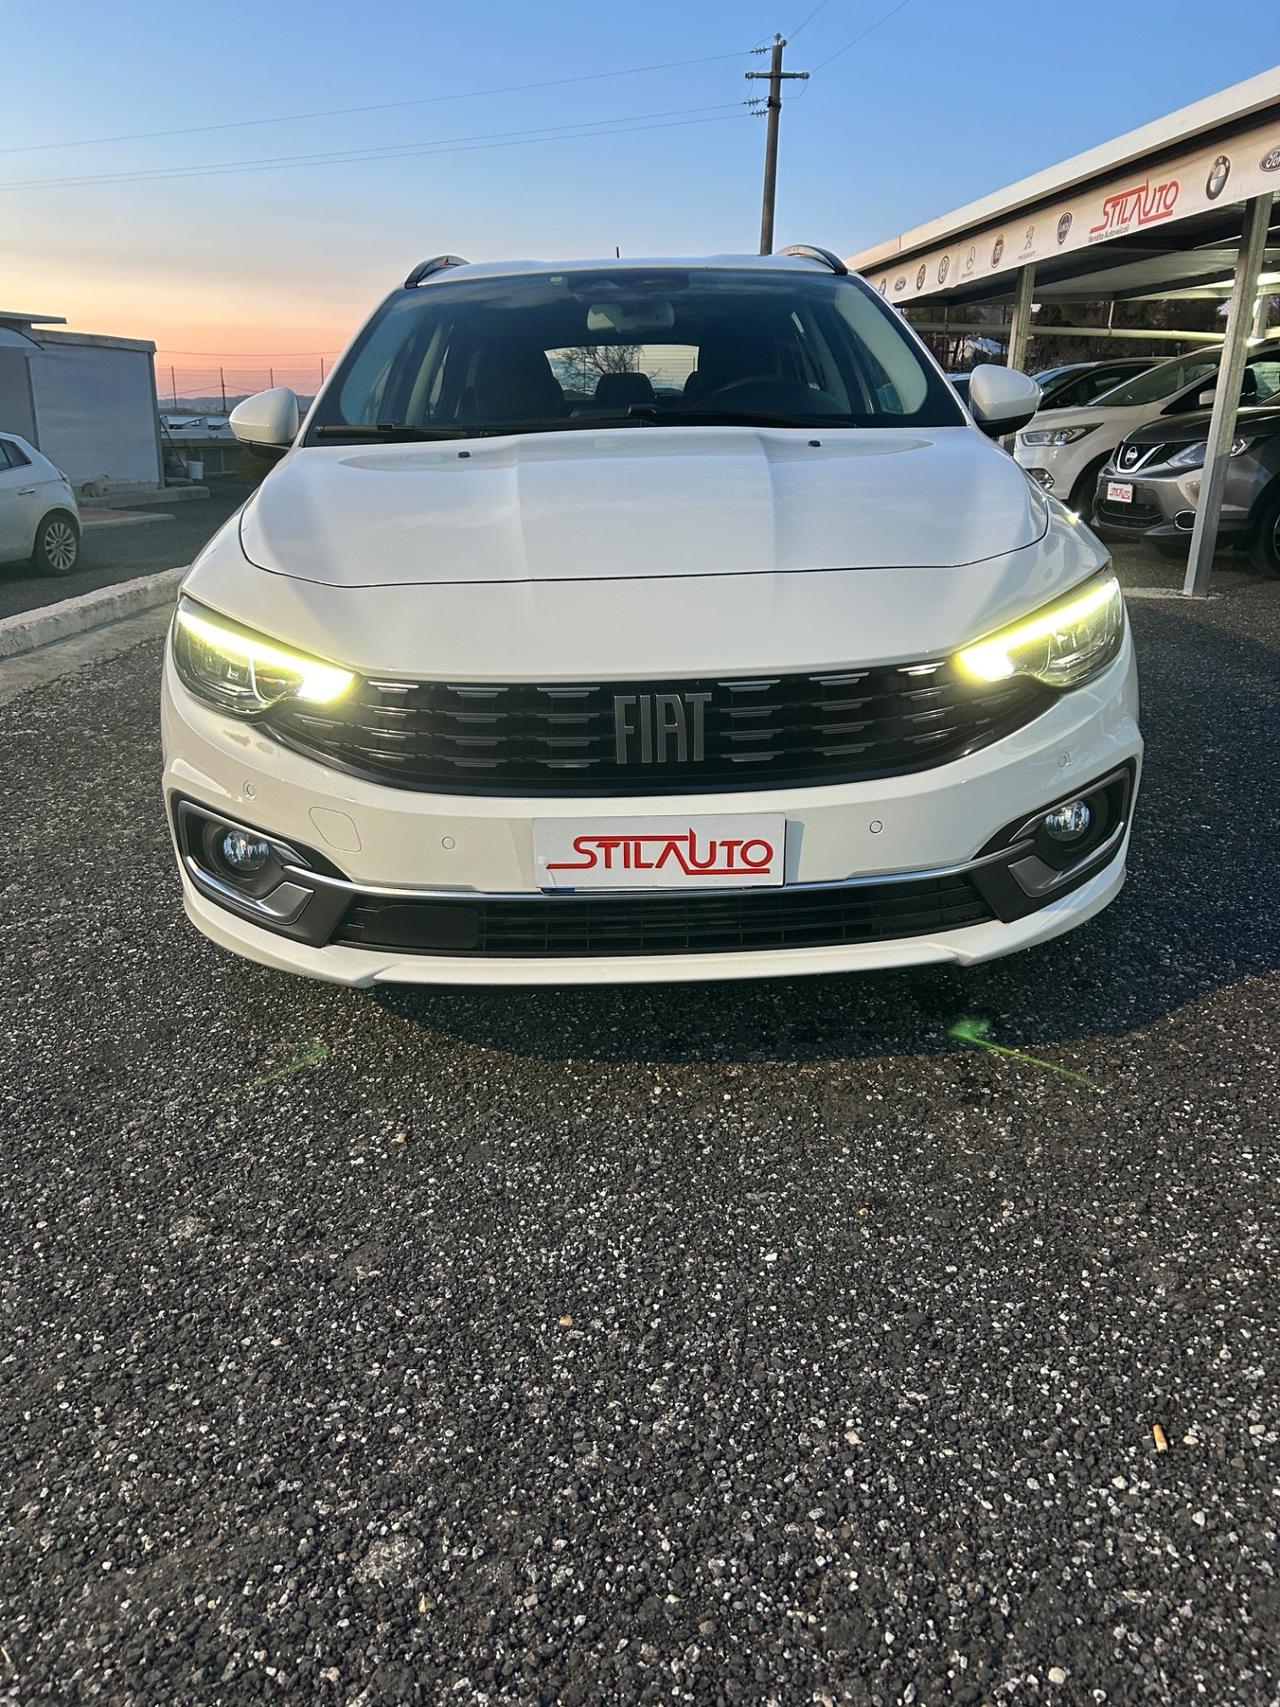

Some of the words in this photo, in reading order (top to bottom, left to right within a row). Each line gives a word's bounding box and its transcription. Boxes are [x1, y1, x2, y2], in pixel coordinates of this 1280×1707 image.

[1090, 177, 1179, 233] STILAUTO
[614, 692, 712, 764] FIAT
[546, 827, 774, 875] STILAUTO
